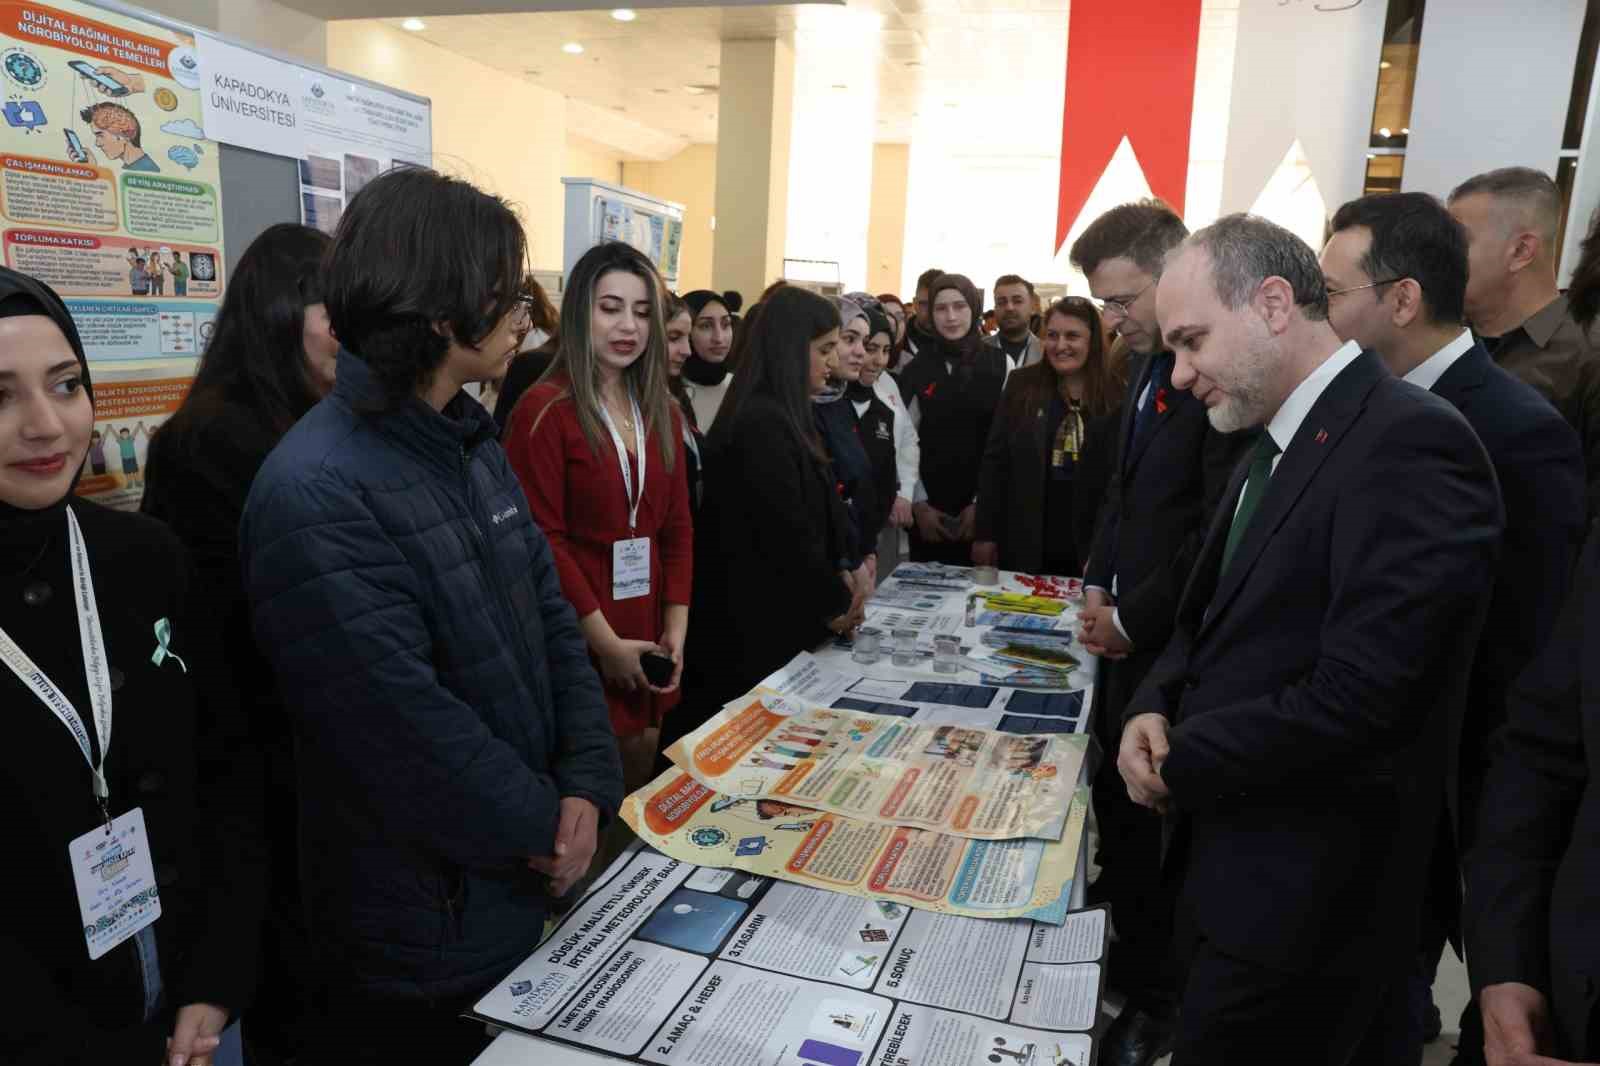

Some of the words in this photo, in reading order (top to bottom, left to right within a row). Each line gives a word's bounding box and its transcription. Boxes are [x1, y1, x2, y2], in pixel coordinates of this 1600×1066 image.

[17, 22, 110, 55] NÖROBİYOLOJİK
[113, 48, 166, 69] TEMELLERİ
[23, 10, 68, 32] DİJİTAL
[71, 24, 160, 56] BAĞIMLILIKLARIN
[213, 73, 291, 107] KAPADOKYA
[210, 92, 296, 129] ÜNİVERSİTESİ
[14, 232, 60, 244] TOPLUMA
[562, 933, 606, 969] İRTİFALI
[601, 877, 663, 934] METEOROLOJİK
[657, 861, 680, 879] BALO
[580, 893, 624, 935] MALİYETLİ
[618, 866, 653, 893] YÜKSEK
[728, 913, 768, 957] 3.TASARIM
[609, 950, 634, 972] BALON
[886, 947, 917, 988] 5.SONUÇ
[573, 1008, 600, 1032] NEDİR
[595, 957, 646, 1008] (RADİOSONDE)
[695, 974, 723, 1005] HEDEF
[666, 1014, 697, 1044] AMAÇ
[689, 1005, 702, 1014] &
[657, 1045, 673, 1056] 2.
[879, 1012, 913, 1066] TİREBİLECEK
